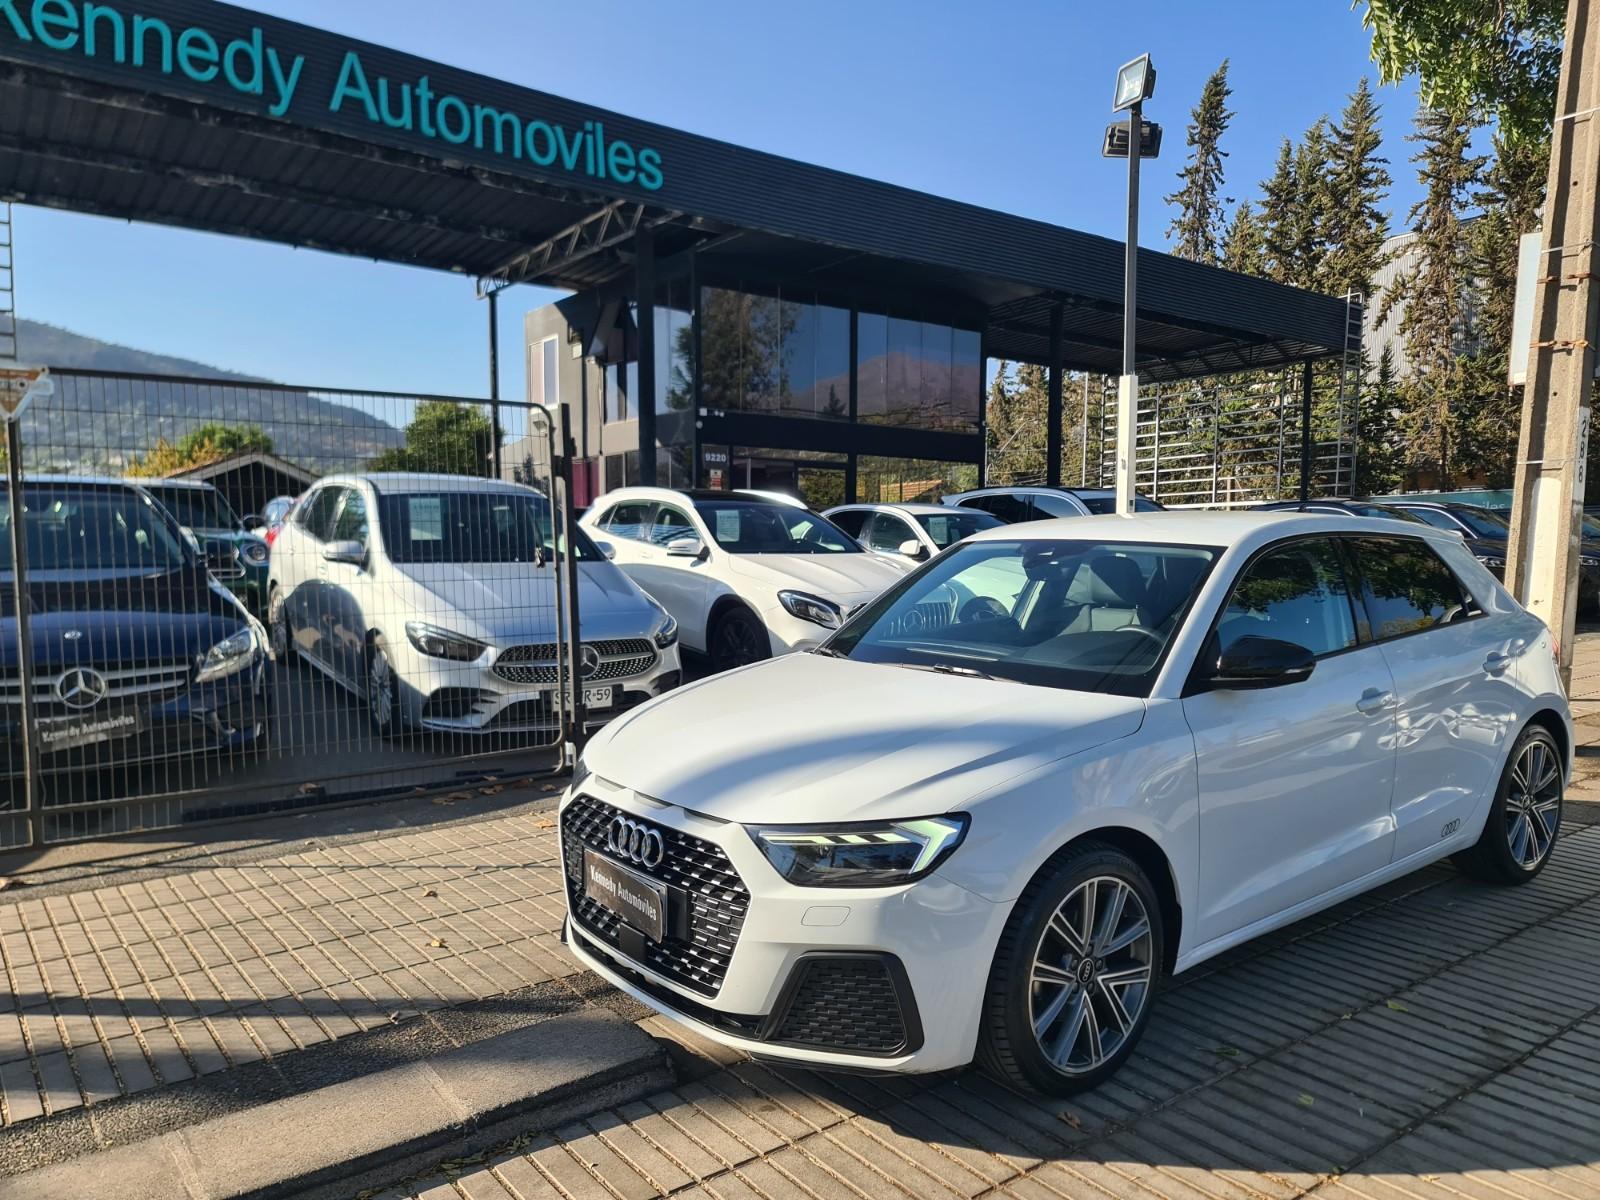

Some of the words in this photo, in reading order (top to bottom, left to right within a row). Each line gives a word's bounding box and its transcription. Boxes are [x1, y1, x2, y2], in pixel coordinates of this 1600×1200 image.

[328, 51, 664, 191] Automoviles
[705, 452, 727, 463] 9220
[590, 864, 617, 897] Kennedy
